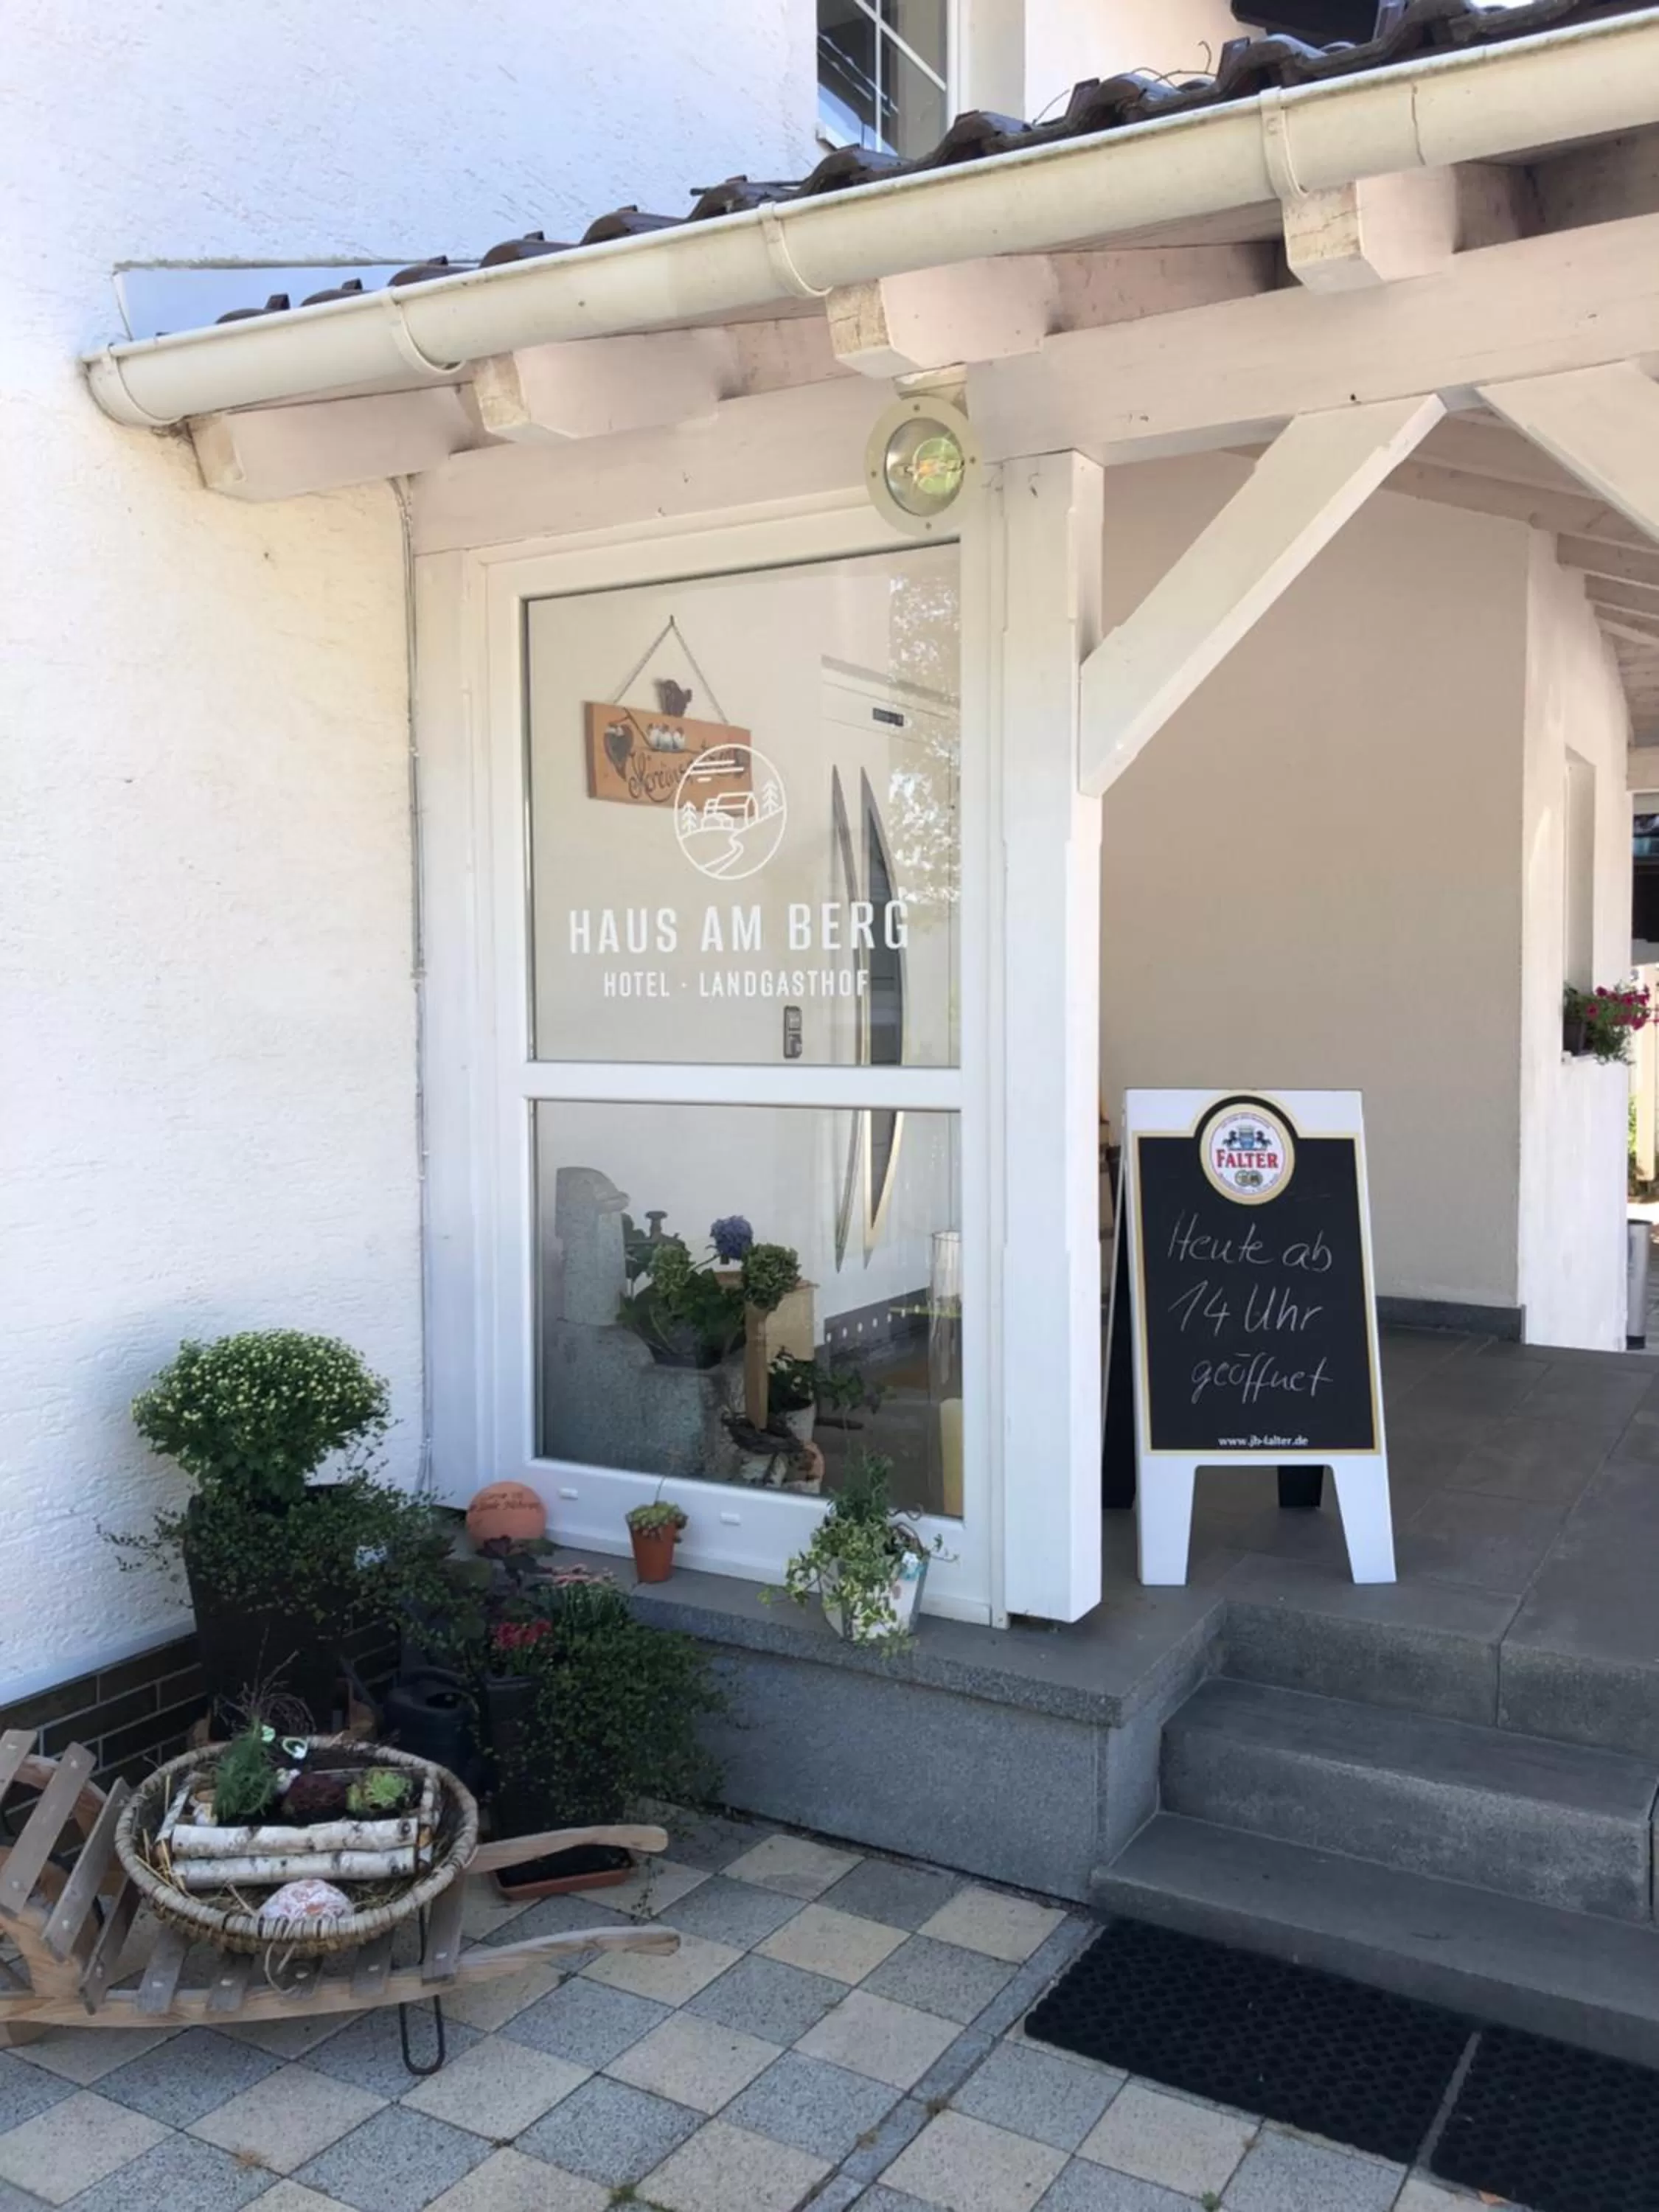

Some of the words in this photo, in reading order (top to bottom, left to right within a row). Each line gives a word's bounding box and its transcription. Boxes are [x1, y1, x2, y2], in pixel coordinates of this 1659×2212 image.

[569, 908, 678, 954] HAUS
[701, 905, 762, 951] AM
[788, 900, 909, 951] BERG
[603, 971, 670, 998] HOTEL
[700, 969, 870, 997] LANDGASTHOF
[1216, 1148, 1279, 1169] FALTER
[1168, 1210, 1273, 1266] Heute
[1282, 1228, 1333, 1272] ab
[1168, 1280, 1231, 1336] 14
[1245, 1283, 1323, 1332] Uhr
